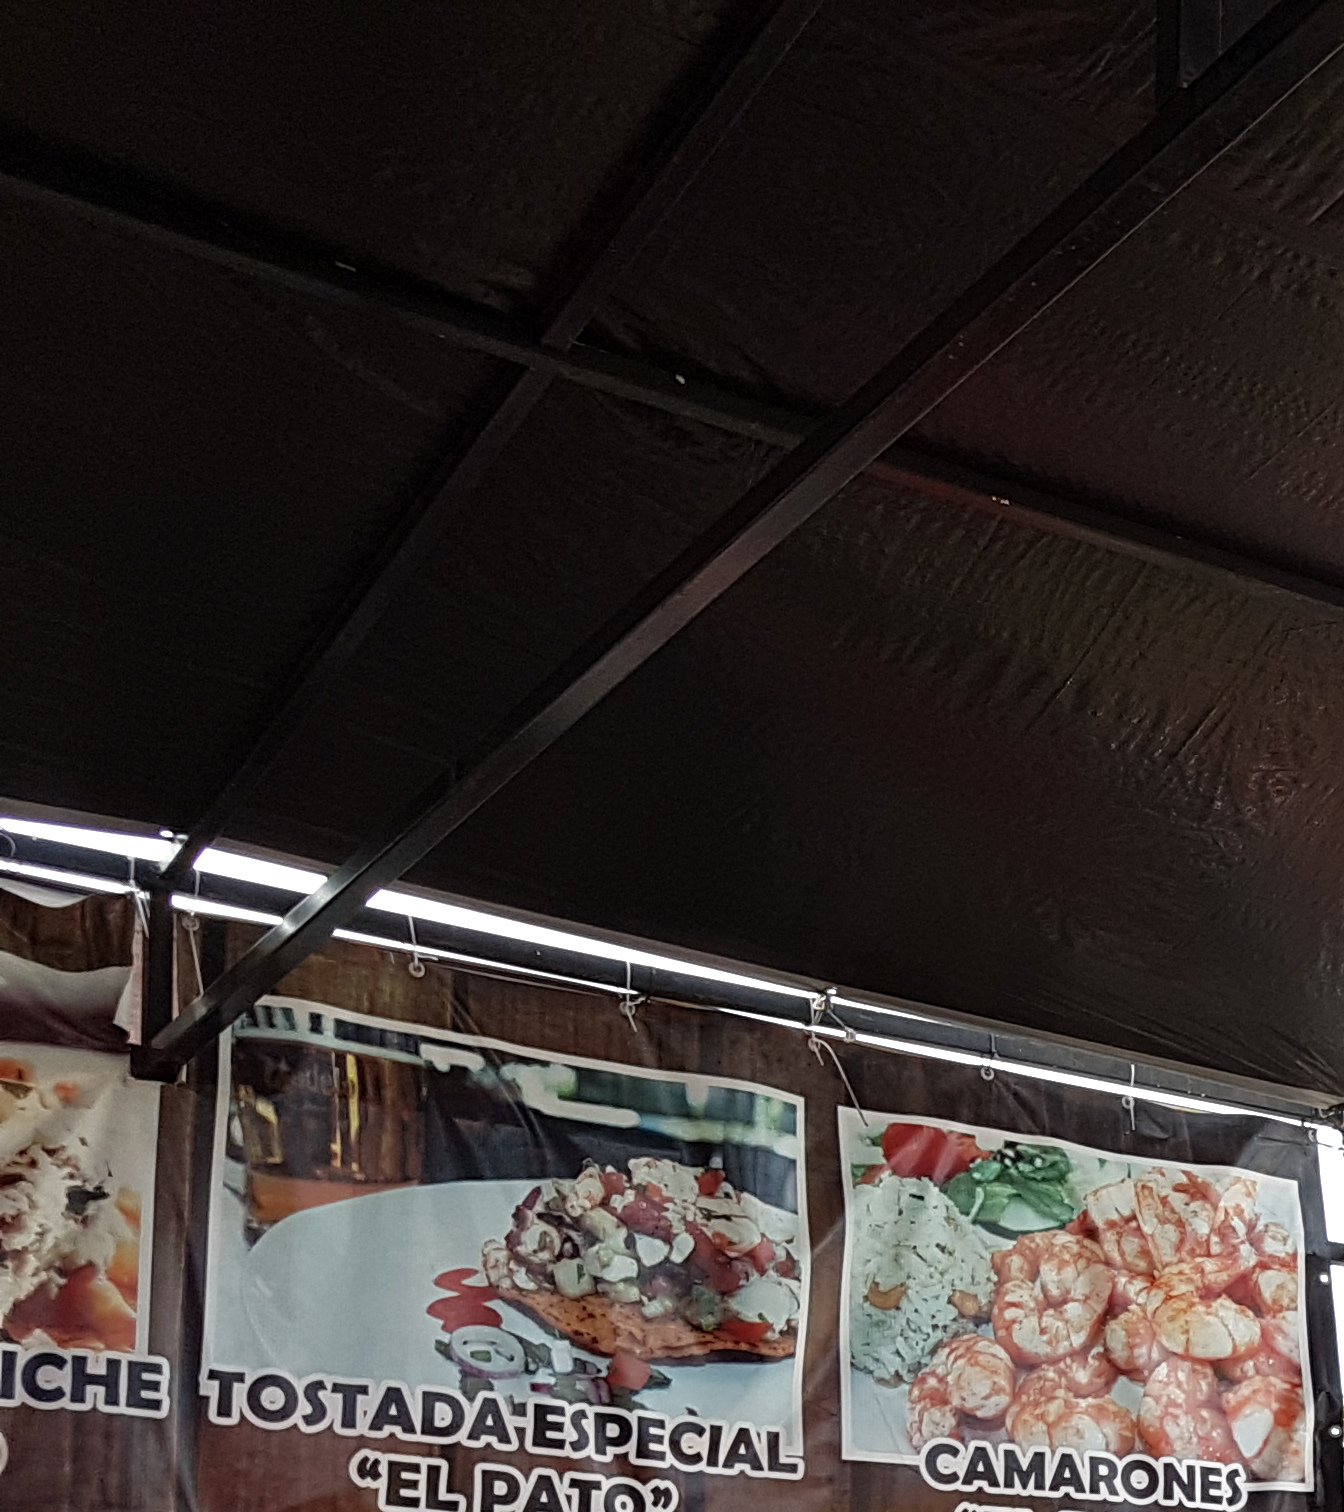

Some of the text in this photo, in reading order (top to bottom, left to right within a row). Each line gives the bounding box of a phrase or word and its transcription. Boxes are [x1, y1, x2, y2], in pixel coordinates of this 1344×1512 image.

[207, 1368, 800, 1474] TOSTADA ESPECIAL
[924, 1443, 1244, 1507] CAMARONES
